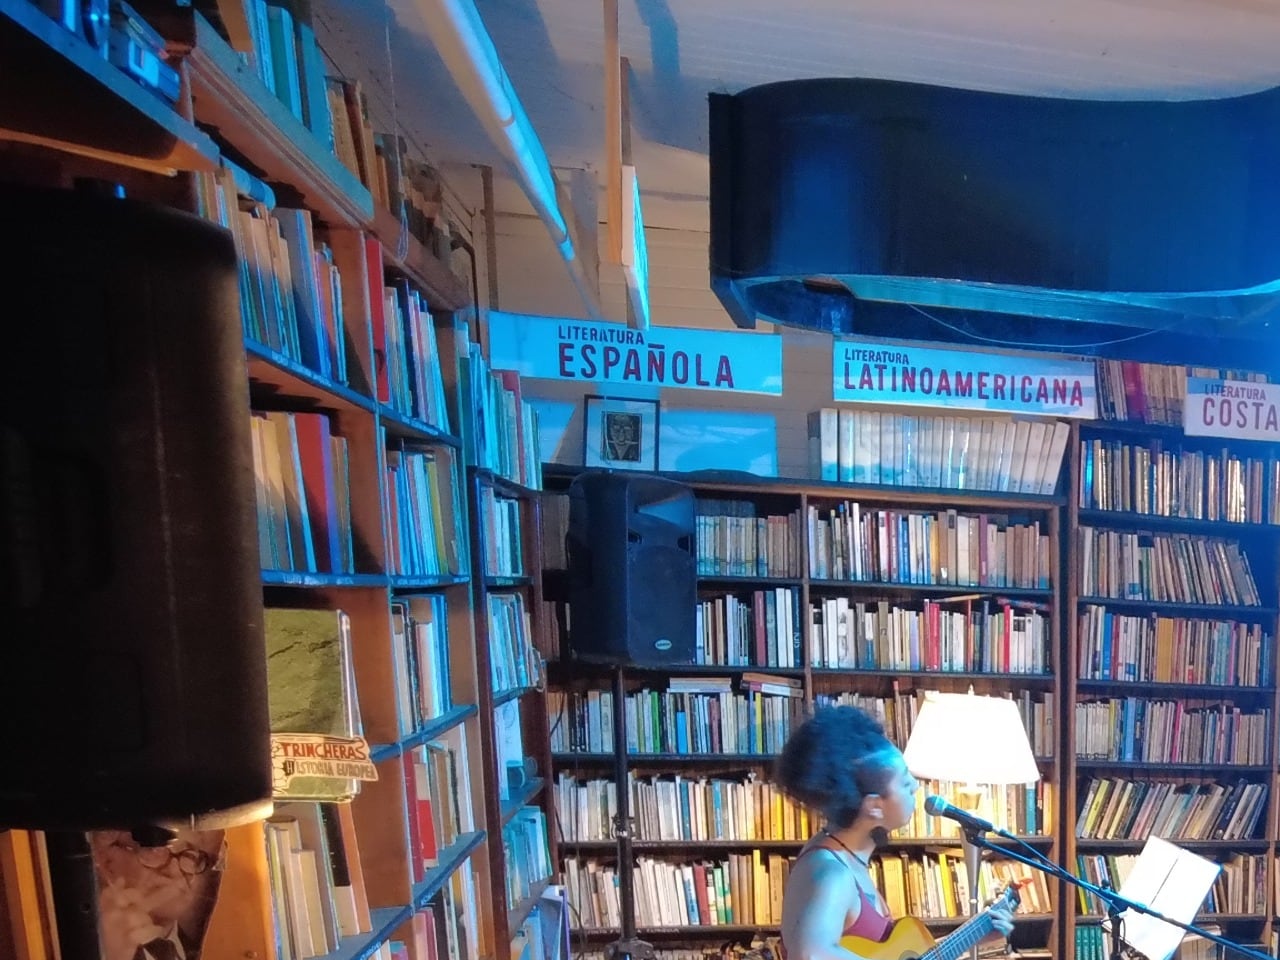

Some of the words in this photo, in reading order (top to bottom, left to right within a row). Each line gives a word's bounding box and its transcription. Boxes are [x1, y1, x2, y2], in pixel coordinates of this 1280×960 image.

[558, 325, 645, 346] LITERATURA
[558, 342, 735, 389] ESPAÑOLA
[844, 347, 910, 365] LITERATURA
[844, 361, 1084, 407] LATINOAMERICANA
[1204, 383, 1267, 401] LITERATURA
[280, 741, 367, 760] TRINCHERAS
